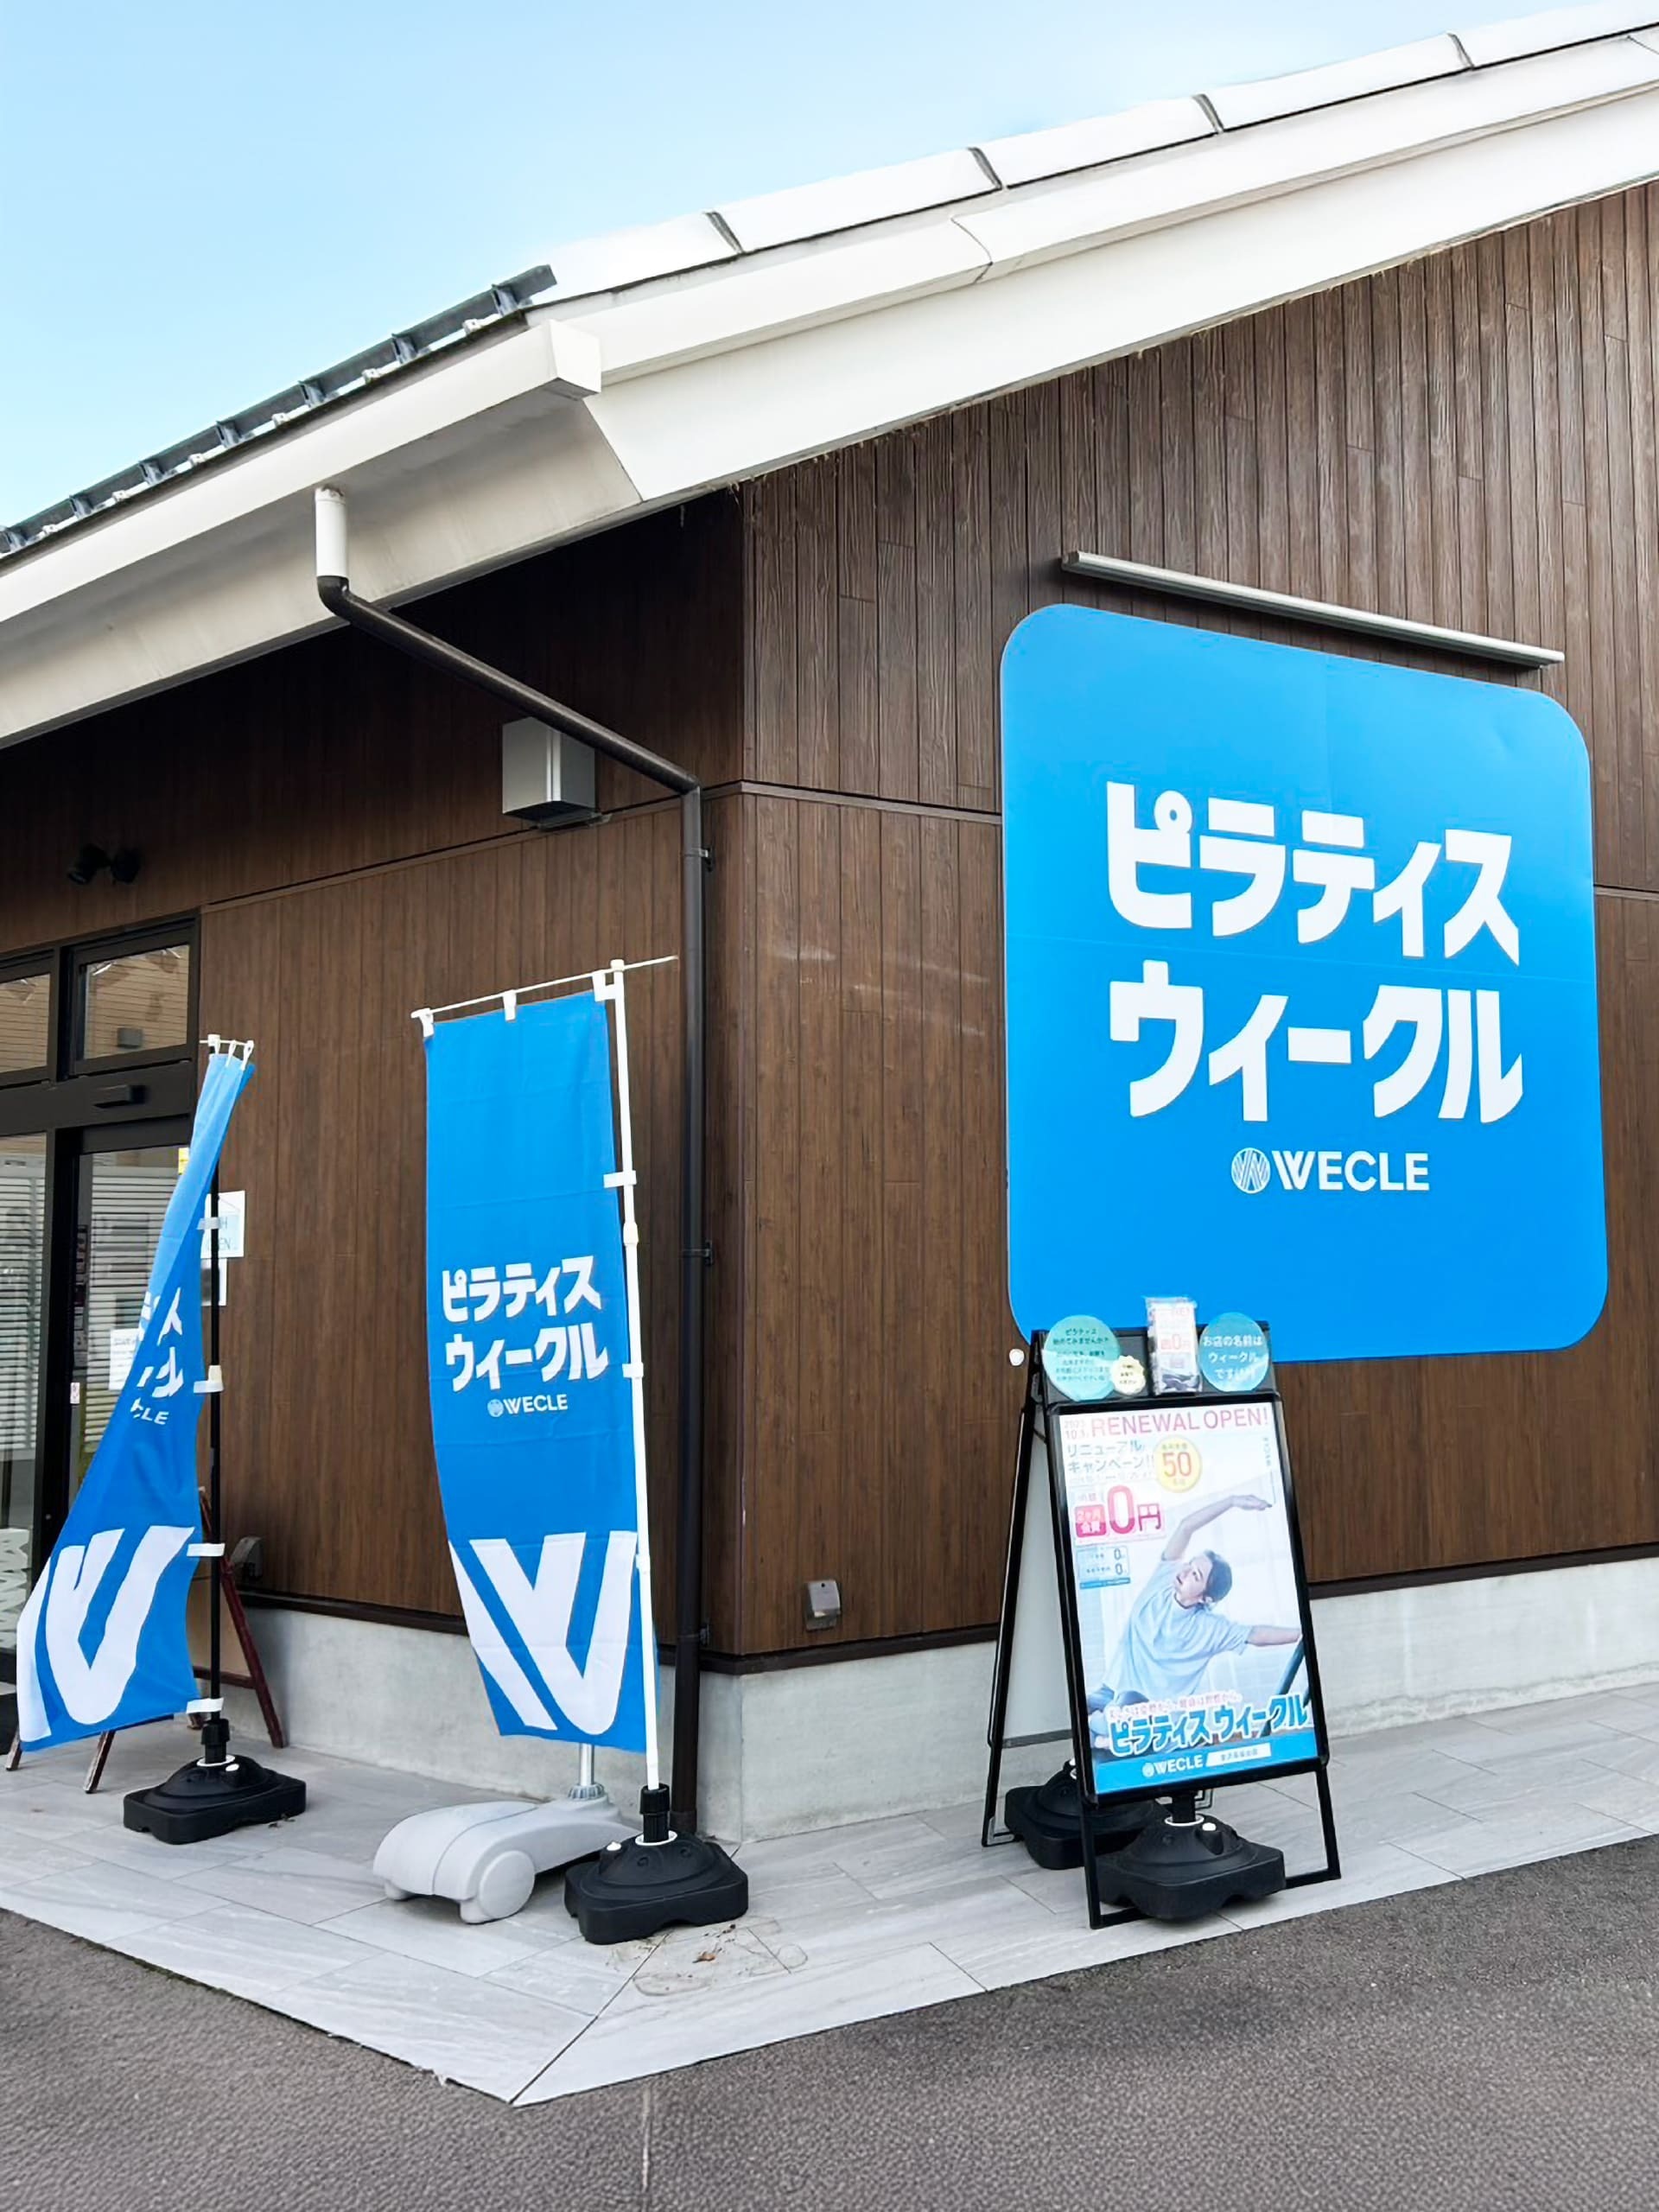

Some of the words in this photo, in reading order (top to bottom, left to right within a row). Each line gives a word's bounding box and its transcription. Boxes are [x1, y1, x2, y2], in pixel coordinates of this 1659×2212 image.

[1107, 781, 1520, 967] ピラティス
[1109, 959, 1523, 1123] ウィークル
[1272, 1150, 1430, 1192] WECLE
[442, 1255, 602, 1322] ピラティス
[446, 1322, 609, 1393] ウィークル
[503, 1394, 569, 1414] WECLE
[1091, 1411, 1200, 1437] RENEWAL
[1204, 1408, 1269, 1430] OPEN!
[1067, 1440, 1143, 1458] リニューアル
[1162, 1452, 1192, 1478] 50
[1109, 1710, 1211, 1754] ピラティス
[1214, 1695, 1307, 1738] ウィークル
[1154, 1755, 1204, 1775] WECLE
